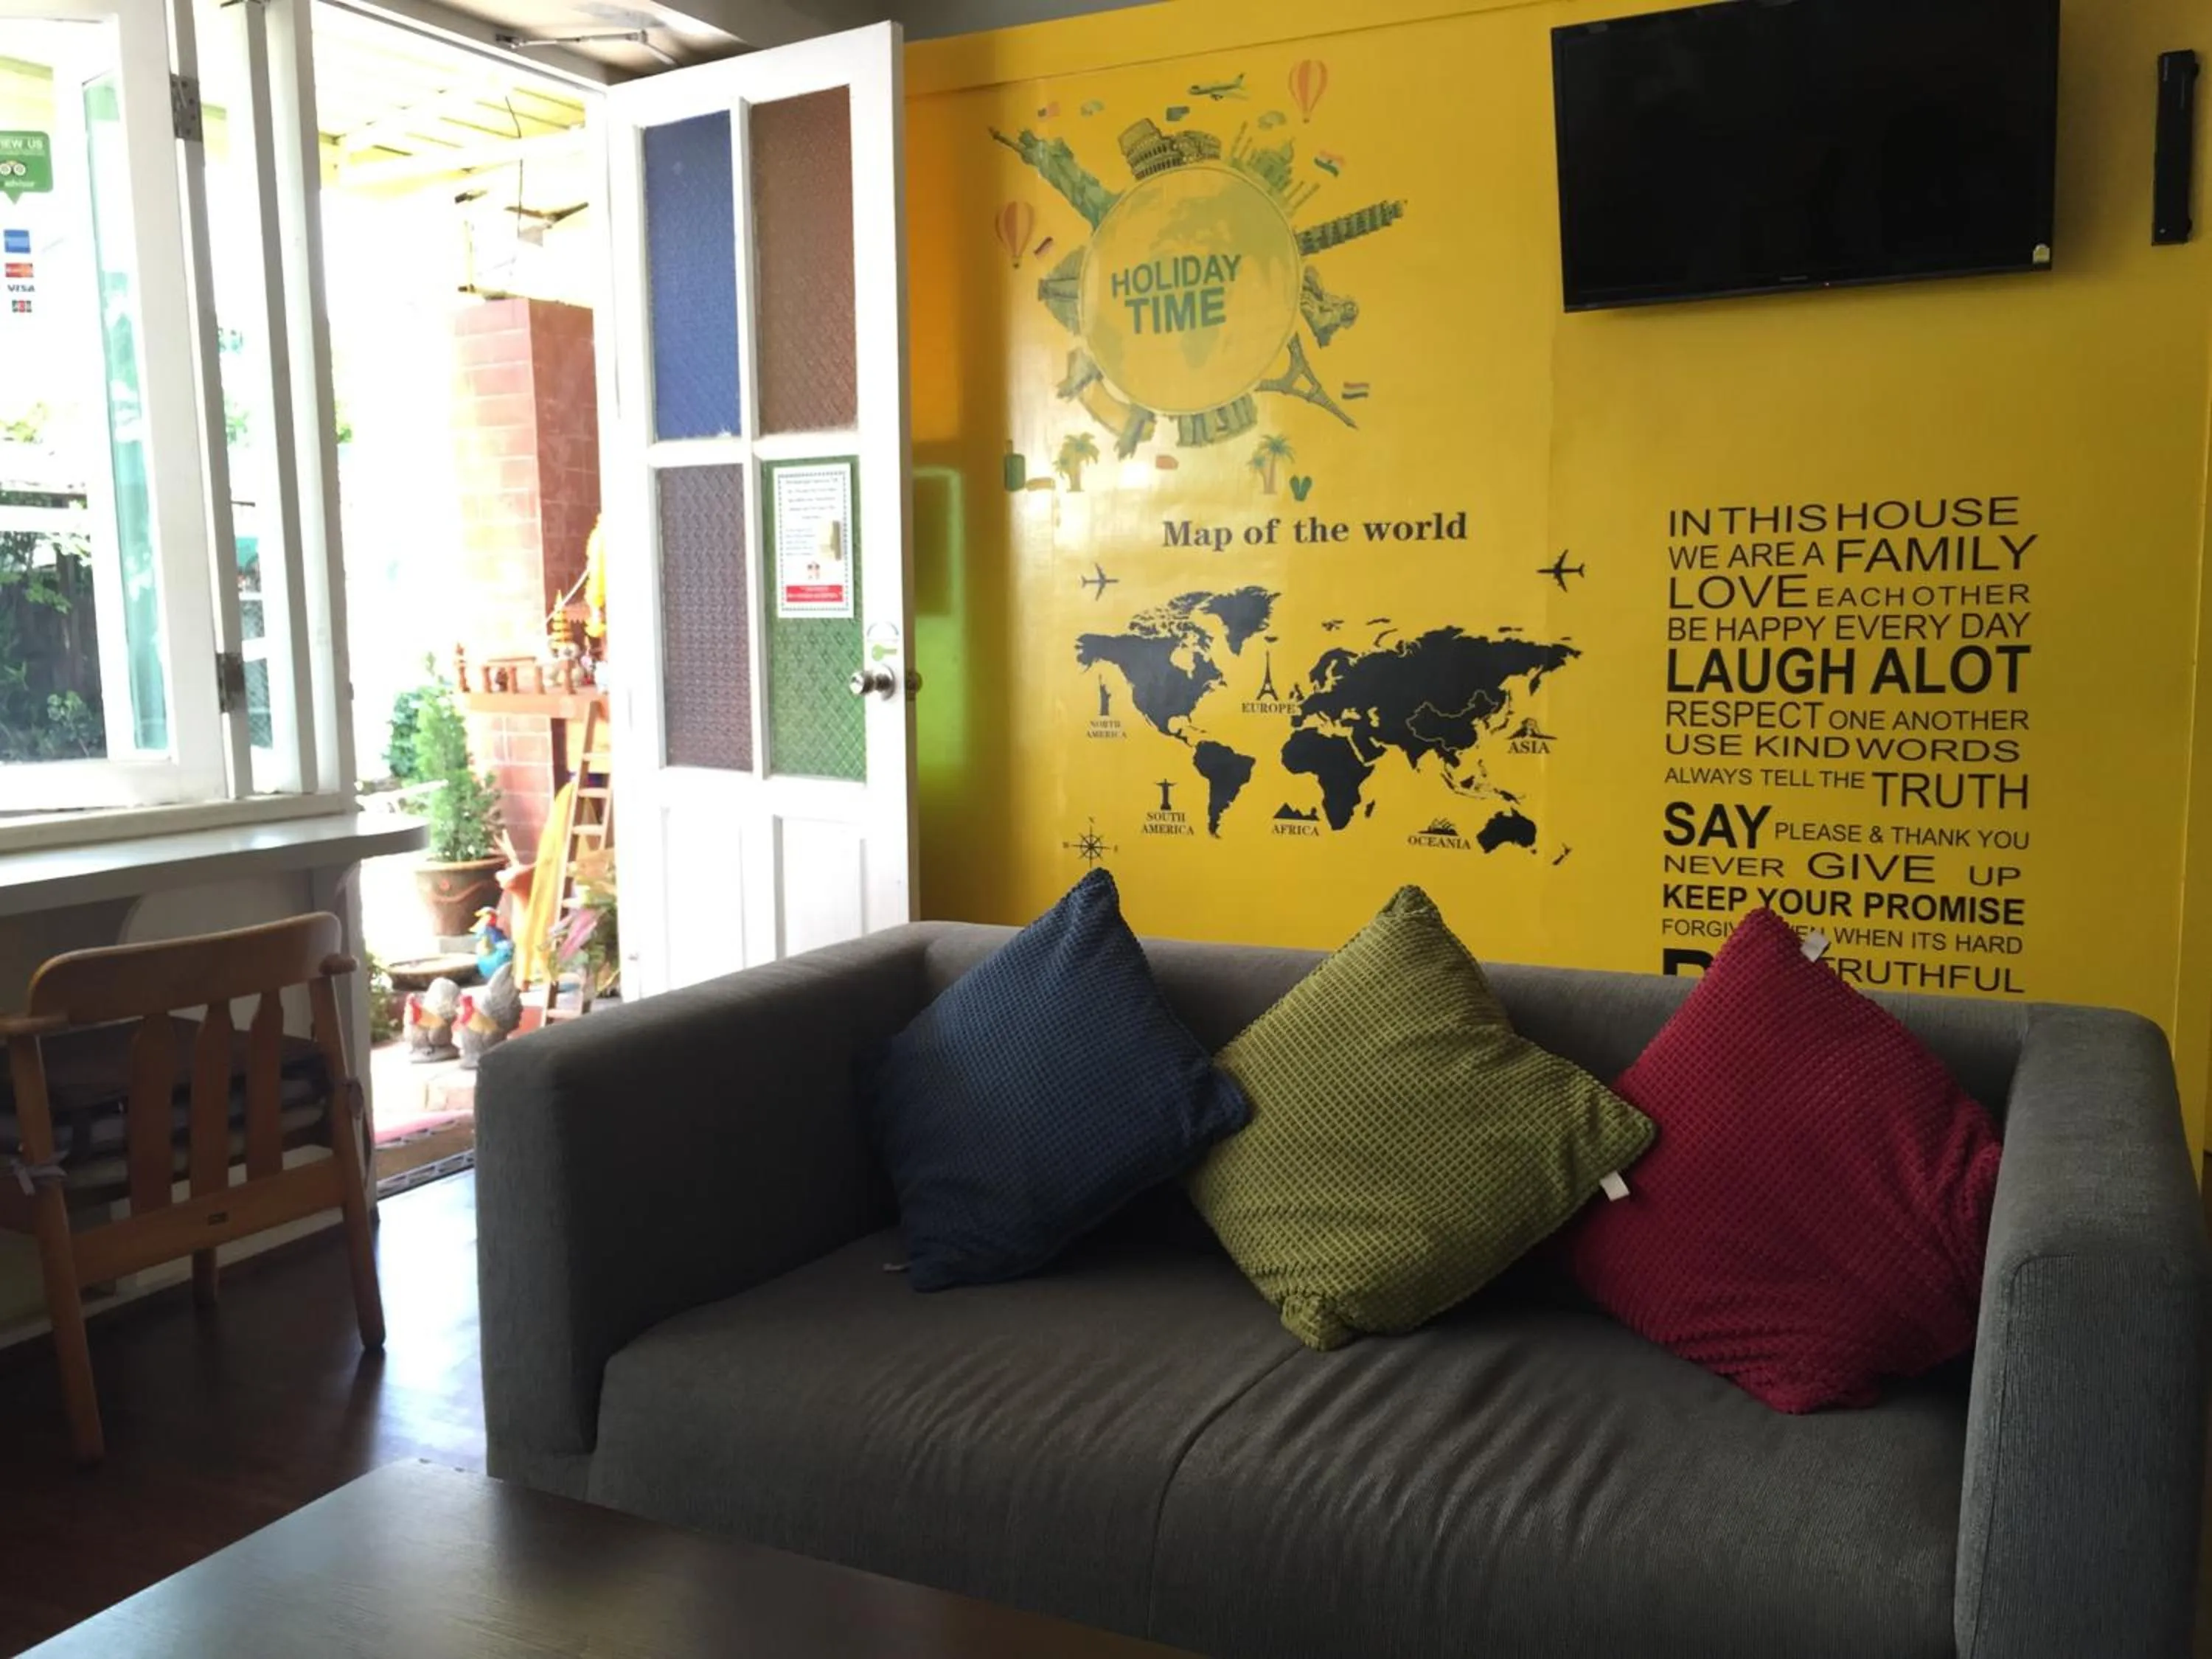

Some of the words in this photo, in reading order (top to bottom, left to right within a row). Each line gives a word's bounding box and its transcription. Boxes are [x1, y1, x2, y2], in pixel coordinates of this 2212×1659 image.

[7, 284, 35, 293] VISA
[1111, 254, 1242, 299] HOLIDAY
[1125, 288, 1226, 334] TIME
[1163, 521, 1233, 552] Map
[1243, 519, 1280, 544] of
[1294, 516, 1349, 543] the
[1362, 512, 1467, 541] world
[1669, 509, 1710, 537] IN
[1719, 504, 1827, 535] THIS
[1837, 497, 2018, 531] HOUSE
[1669, 545, 1718, 569] WE
[1728, 542, 1794, 568] ARE
[1803, 542, 1824, 566] A
[1837, 534, 2037, 572] FAMILY
[1670, 574, 1808, 609] LOVE
[1817, 588, 1905, 607] EACH
[1913, 584, 2030, 606] OTHER
[1669, 617, 1706, 641] BE
[1717, 616, 1826, 641] HAPPY
[1835, 614, 1950, 640] EVERY
[1961, 612, 2031, 638] DAY
[1668, 648, 1854, 693] LAUGH
[1870, 645, 2031, 693] ALOT
[1242, 703, 1295, 714] EUROPE
[1666, 700, 1823, 730] RESPECT
[1829, 710, 1885, 730] ONE
[1893, 710, 2028, 731] ANOTHER
[1507, 740, 1550, 754] ASIA
[1666, 734, 1742, 756] USE
[1756, 736, 1850, 759] KIND
[1857, 739, 2020, 762] WORDS
[1664, 768, 1752, 785] ALWAYS
[1761, 770, 1813, 787] TELL
[1820, 771, 1865, 788] THE
[1872, 773, 2028, 809] TRUTH
[1141, 824, 1194, 836] AMERICA
[1147, 813, 1186, 823] SOUTH
[1270, 824, 1319, 836] AFRICA
[1663, 801, 1772, 849] SAY
[1775, 822, 1861, 843] PLEASE
[1870, 827, 1884, 844] &
[1891, 827, 1970, 846] THANK
[1978, 830, 2029, 849] YOU
[1408, 835, 1470, 849] OCEANIA
[1664, 855, 1784, 877] NEVER
[1808, 852, 1935, 883] GIVE
[1969, 866, 2020, 886] UP
[1663, 884, 1747, 911] KEEP
[1758, 888, 1851, 917] YOUR
[1864, 893, 2025, 925] PROMISE
[1663, 919, 1733, 936] FORGI
[1834, 928, 1903, 948] WHEN
[1912, 932, 1946, 950] ITS
[1955, 935, 2023, 954] HARD
